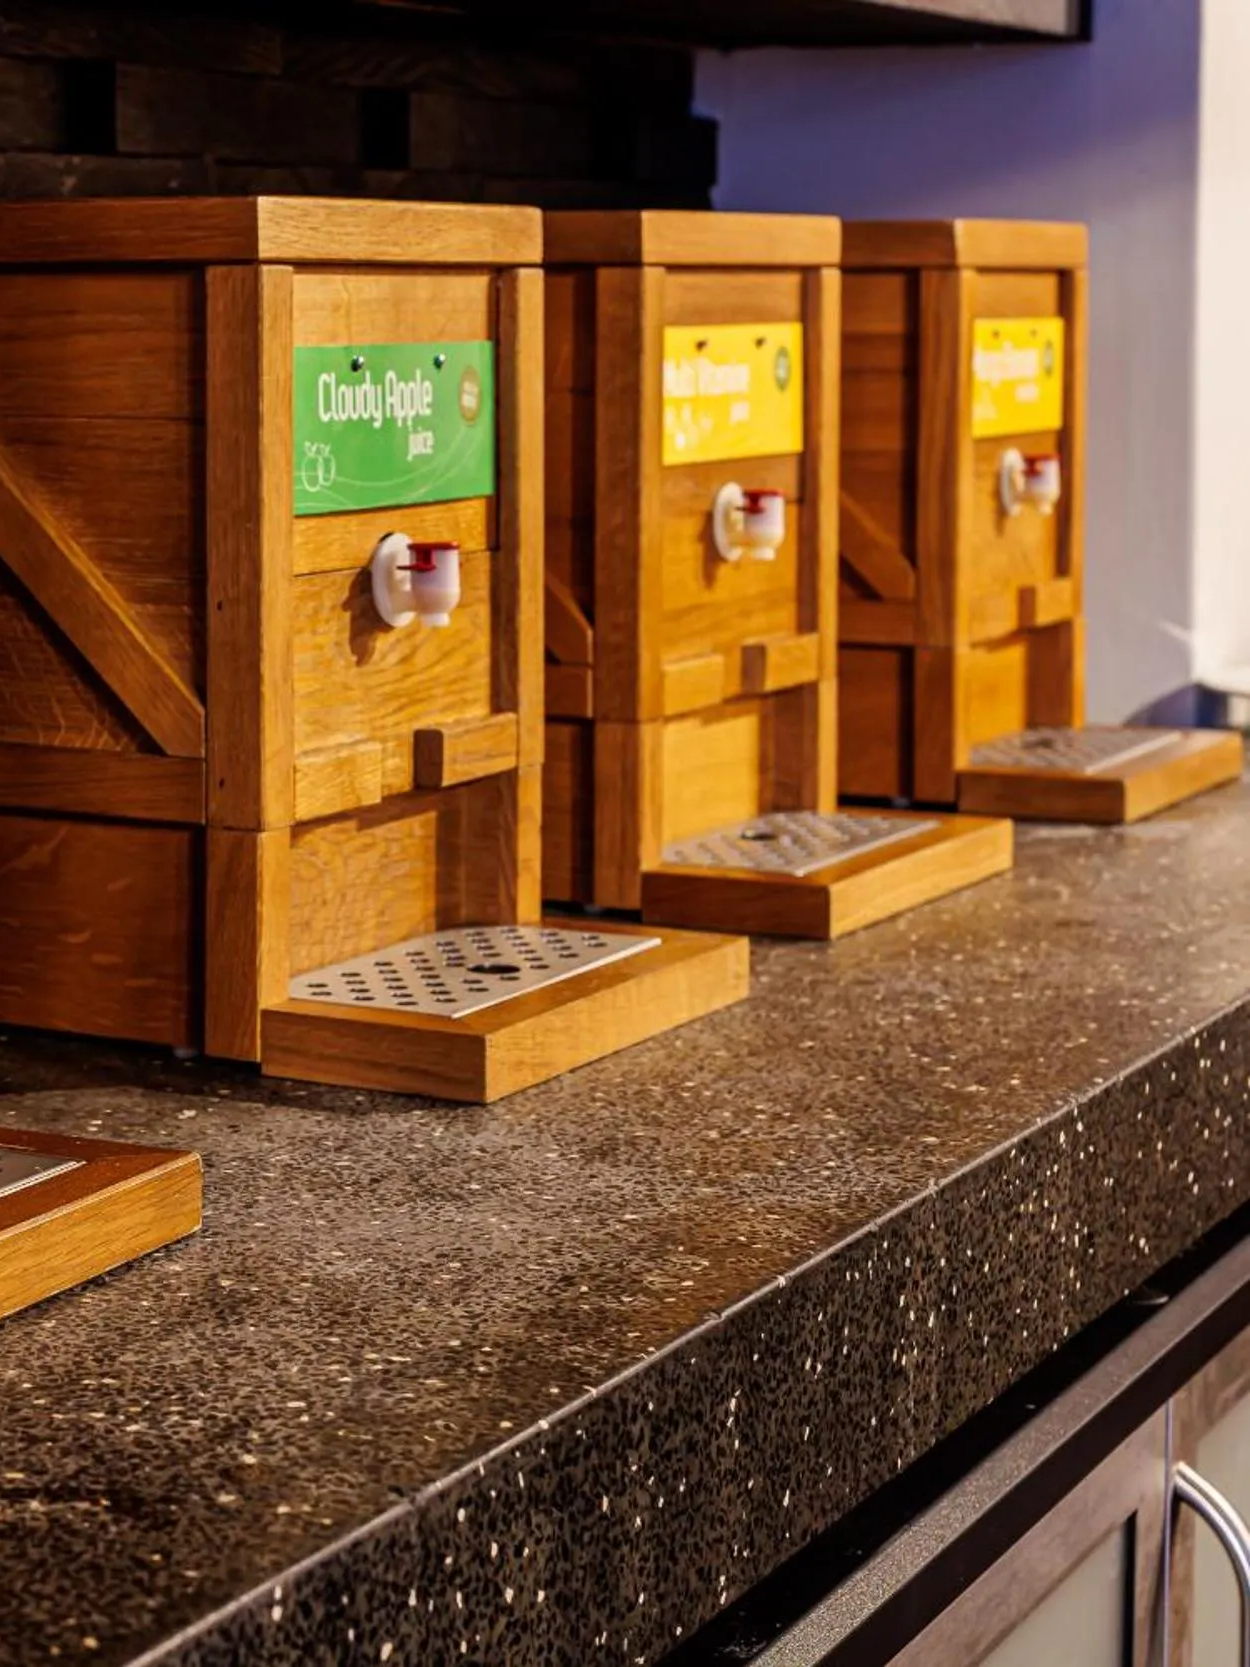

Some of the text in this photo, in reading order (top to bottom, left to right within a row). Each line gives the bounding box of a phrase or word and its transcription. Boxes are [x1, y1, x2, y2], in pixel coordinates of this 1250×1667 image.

[318, 370, 382, 429] Cloudy
[385, 368, 433, 427] Apple
[406, 426, 435, 462] juice
